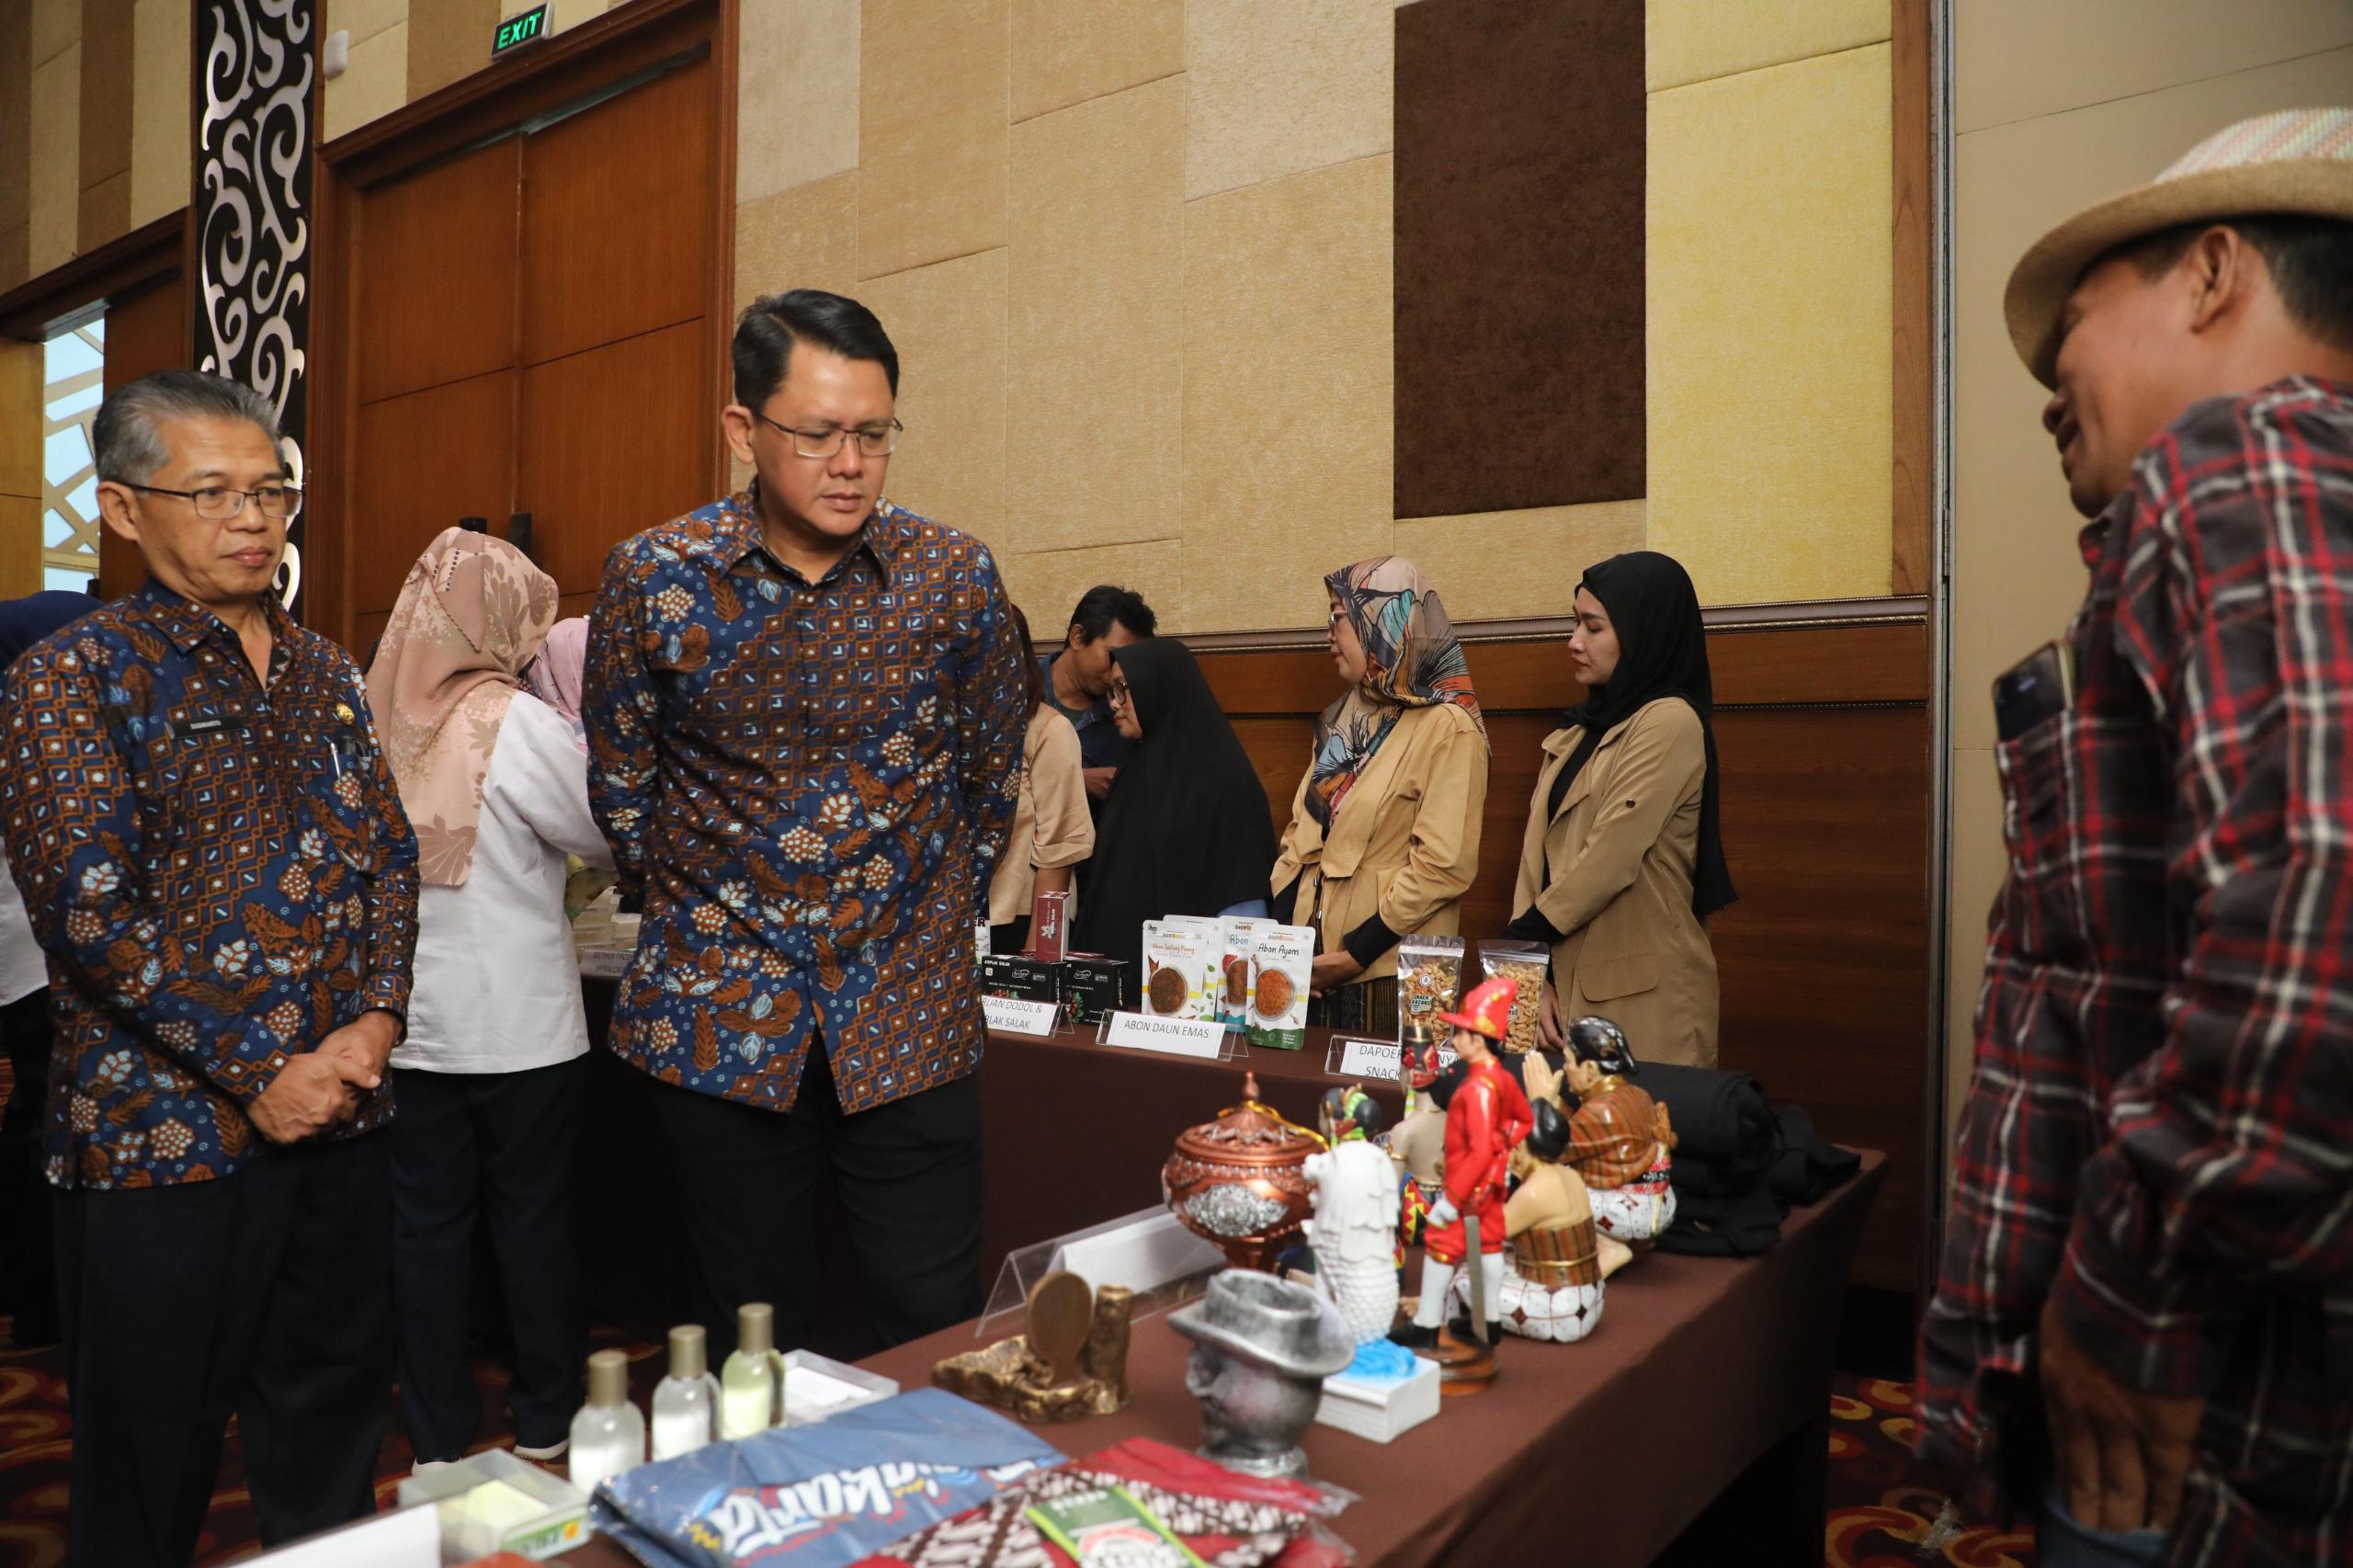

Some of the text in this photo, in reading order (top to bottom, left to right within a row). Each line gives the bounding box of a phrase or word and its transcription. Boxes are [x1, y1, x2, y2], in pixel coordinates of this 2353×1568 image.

[497, 12, 541, 50] EXIT
[1230, 934, 1249, 945] Abon
[1258, 943, 1300, 959] Abon Ayam
[982, 997, 1042, 1014] RLIAN DODOL &
[985, 1015, 1031, 1029] BLAK SALAK
[1123, 1019, 1210, 1039] ABON DAUN EMAS
[1365, 1066, 1401, 1081] SNACK
